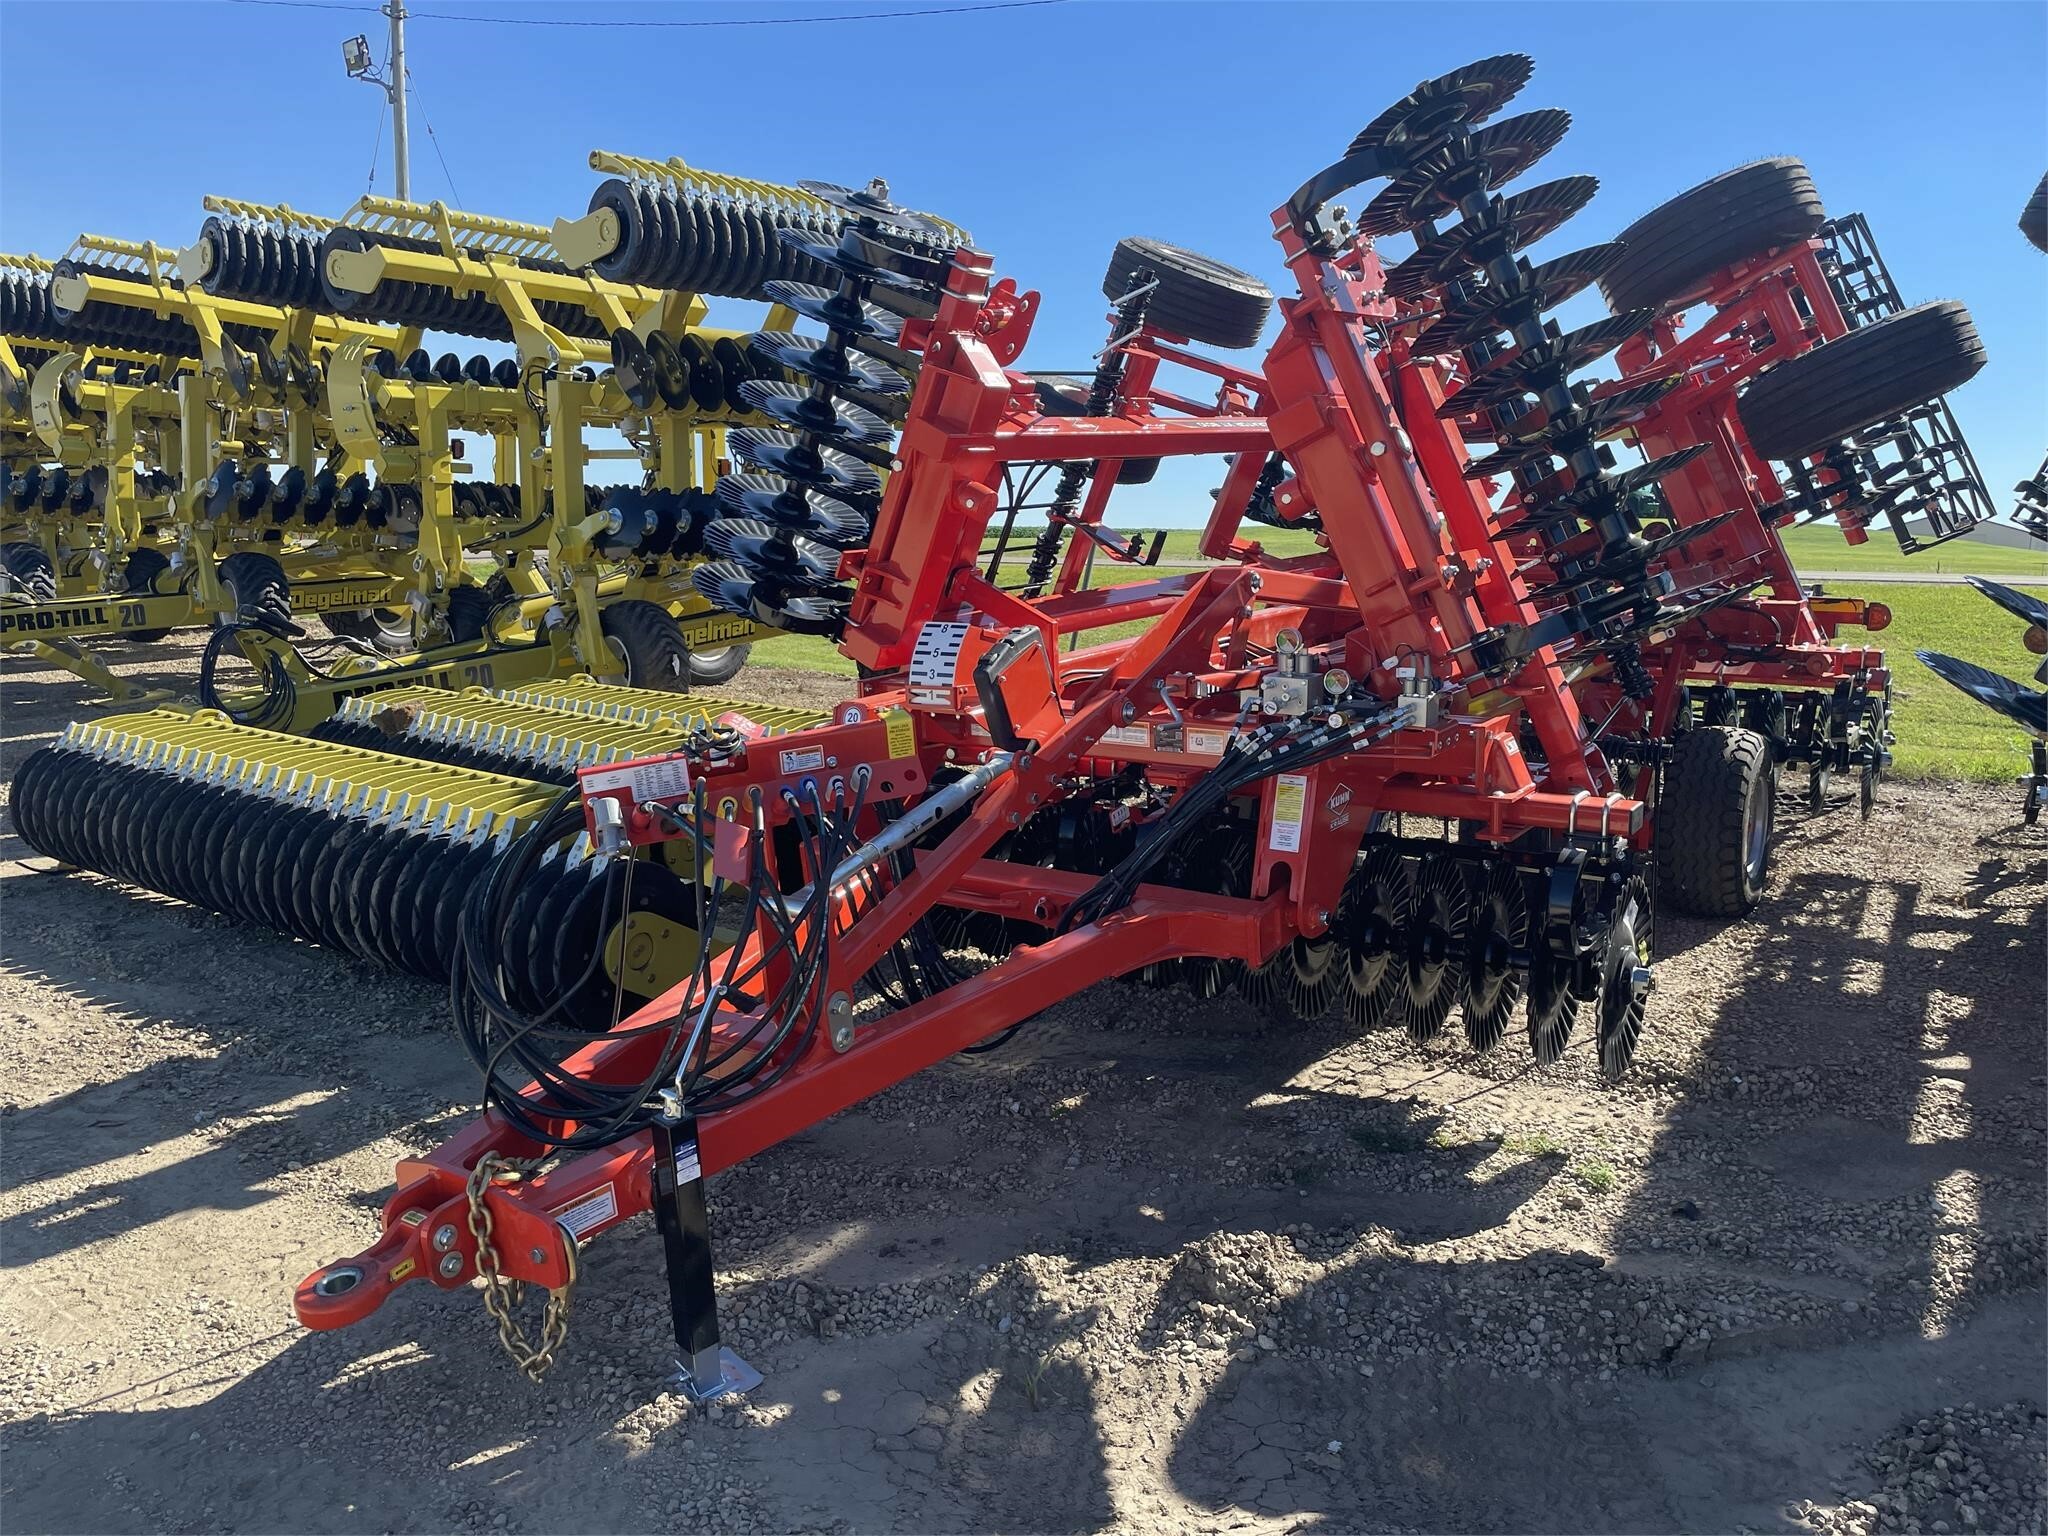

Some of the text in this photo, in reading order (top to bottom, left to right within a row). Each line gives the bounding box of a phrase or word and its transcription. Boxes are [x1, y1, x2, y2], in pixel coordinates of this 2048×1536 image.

[291, 587, 392, 612] Degelman
[119, 604, 147, 628] 20
[683, 619, 756, 651] gelman
[941, 624, 949, 633] 8
[932, 648, 940, 658] 5
[465, 664, 495, 690] 20
[929, 669, 935, 680] 3
[847, 712, 859, 723] 20
[1330, 791, 1350, 809] KUHN
